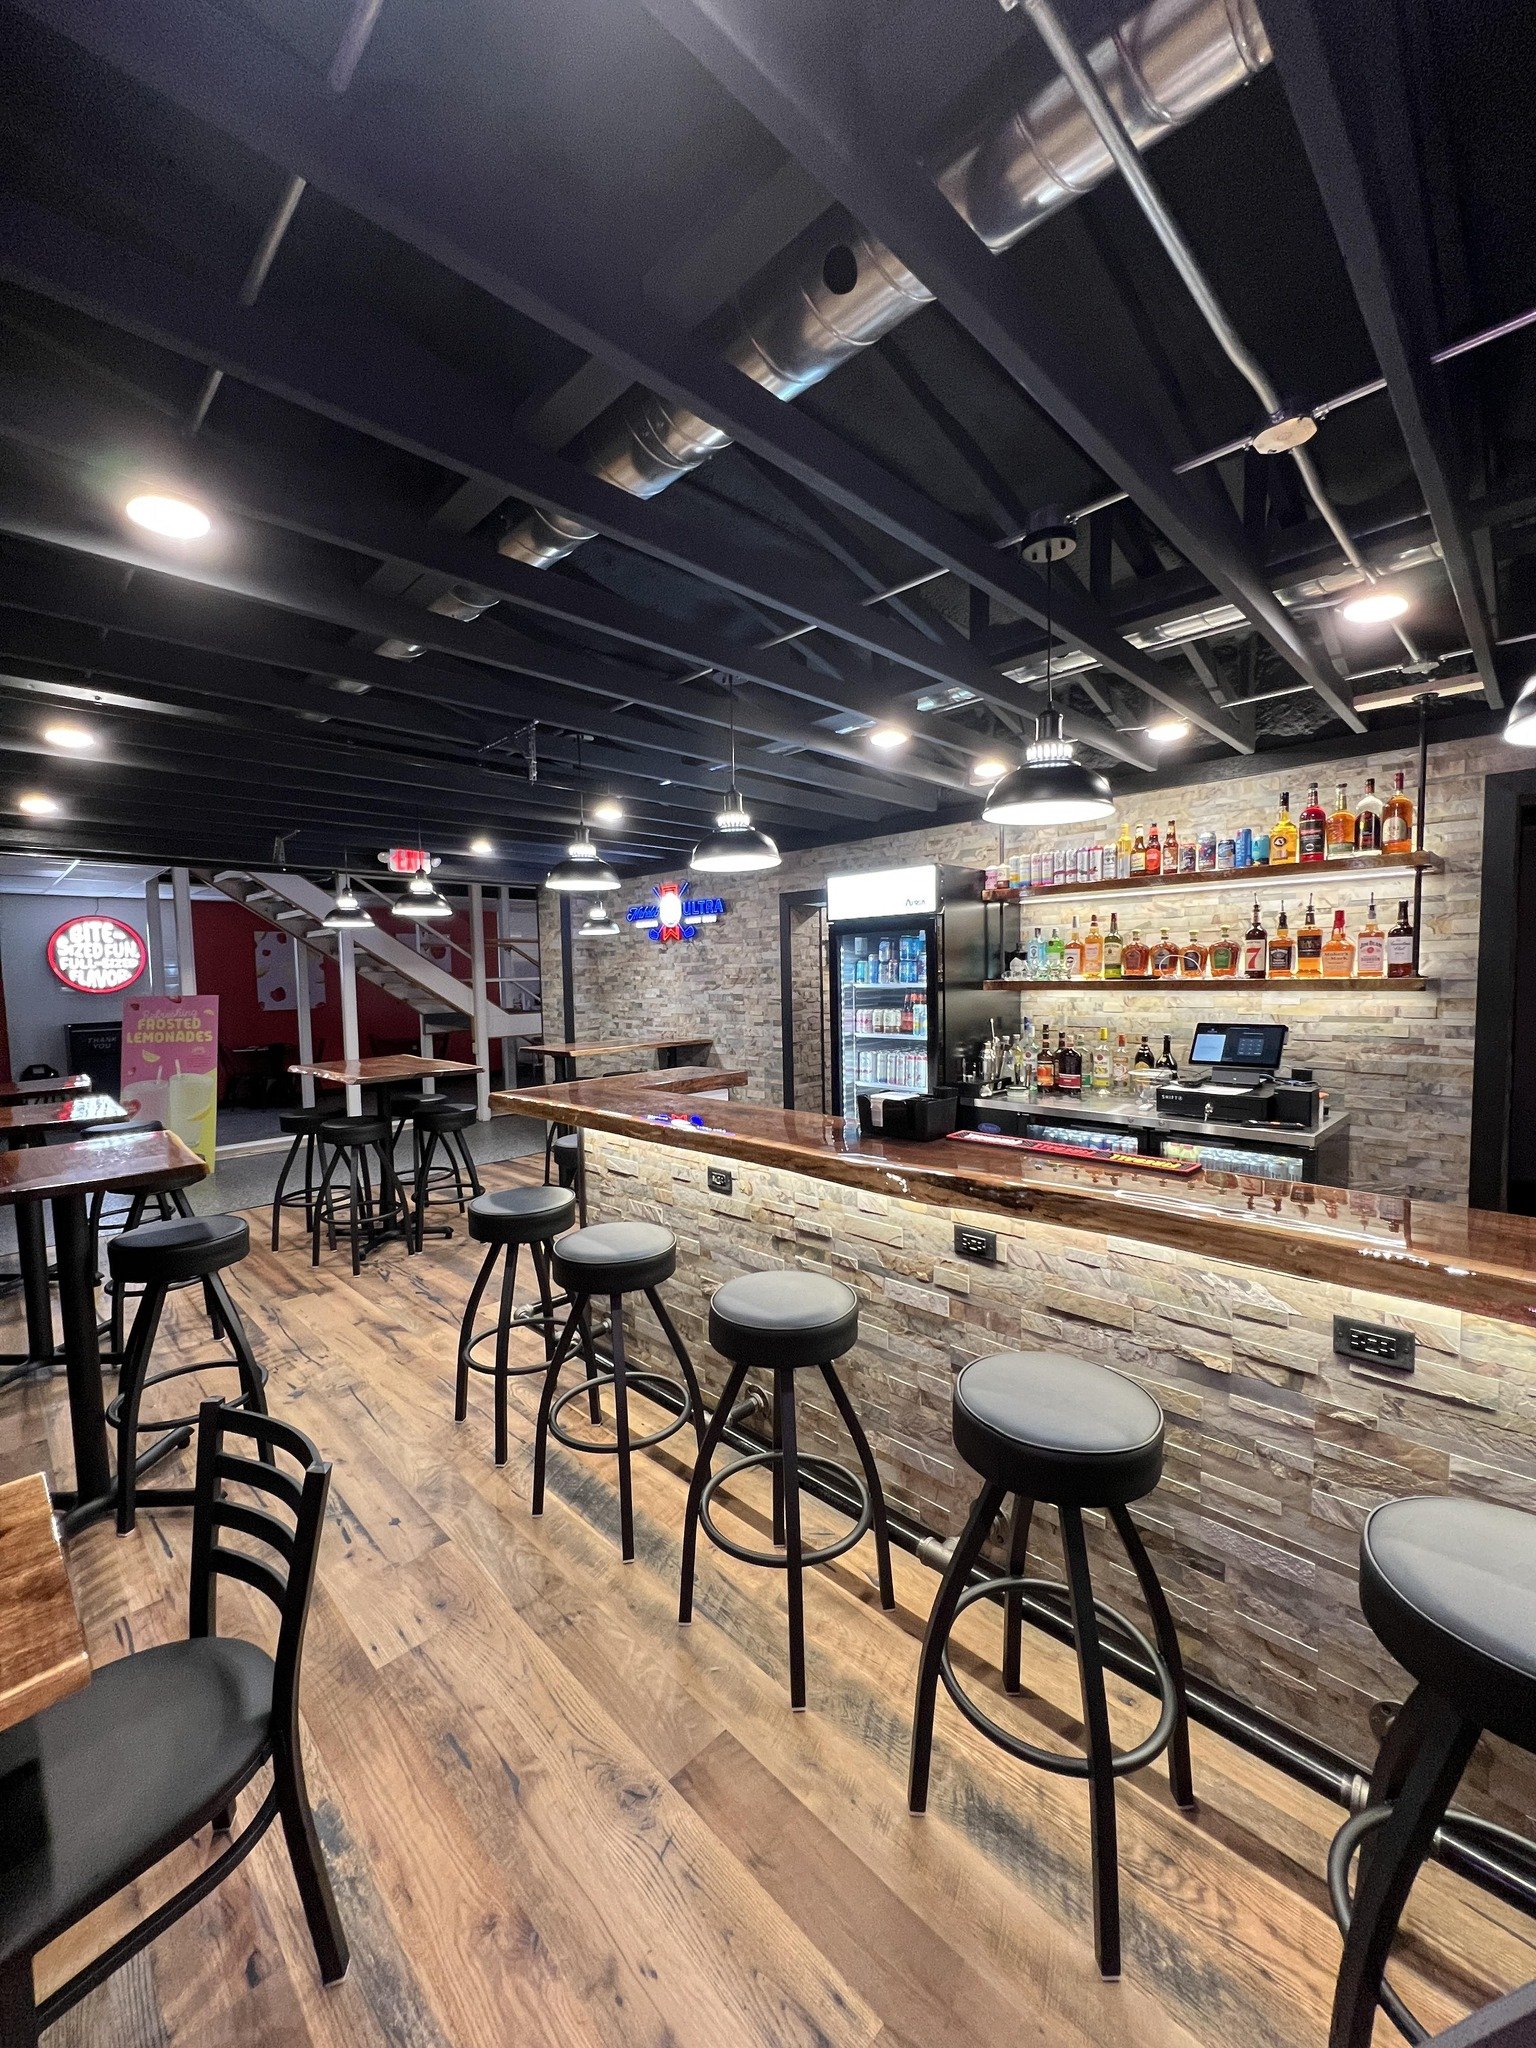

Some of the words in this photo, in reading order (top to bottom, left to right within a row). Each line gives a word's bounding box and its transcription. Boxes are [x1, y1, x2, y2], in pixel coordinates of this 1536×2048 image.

[682, 898, 724, 916] ULTRA
[69, 921, 126, 943] BITE-
[1246, 947, 1262, 969] 7
[137, 1017, 201, 1030] FROSTED
[126, 1030, 213, 1043] LEMONADES
